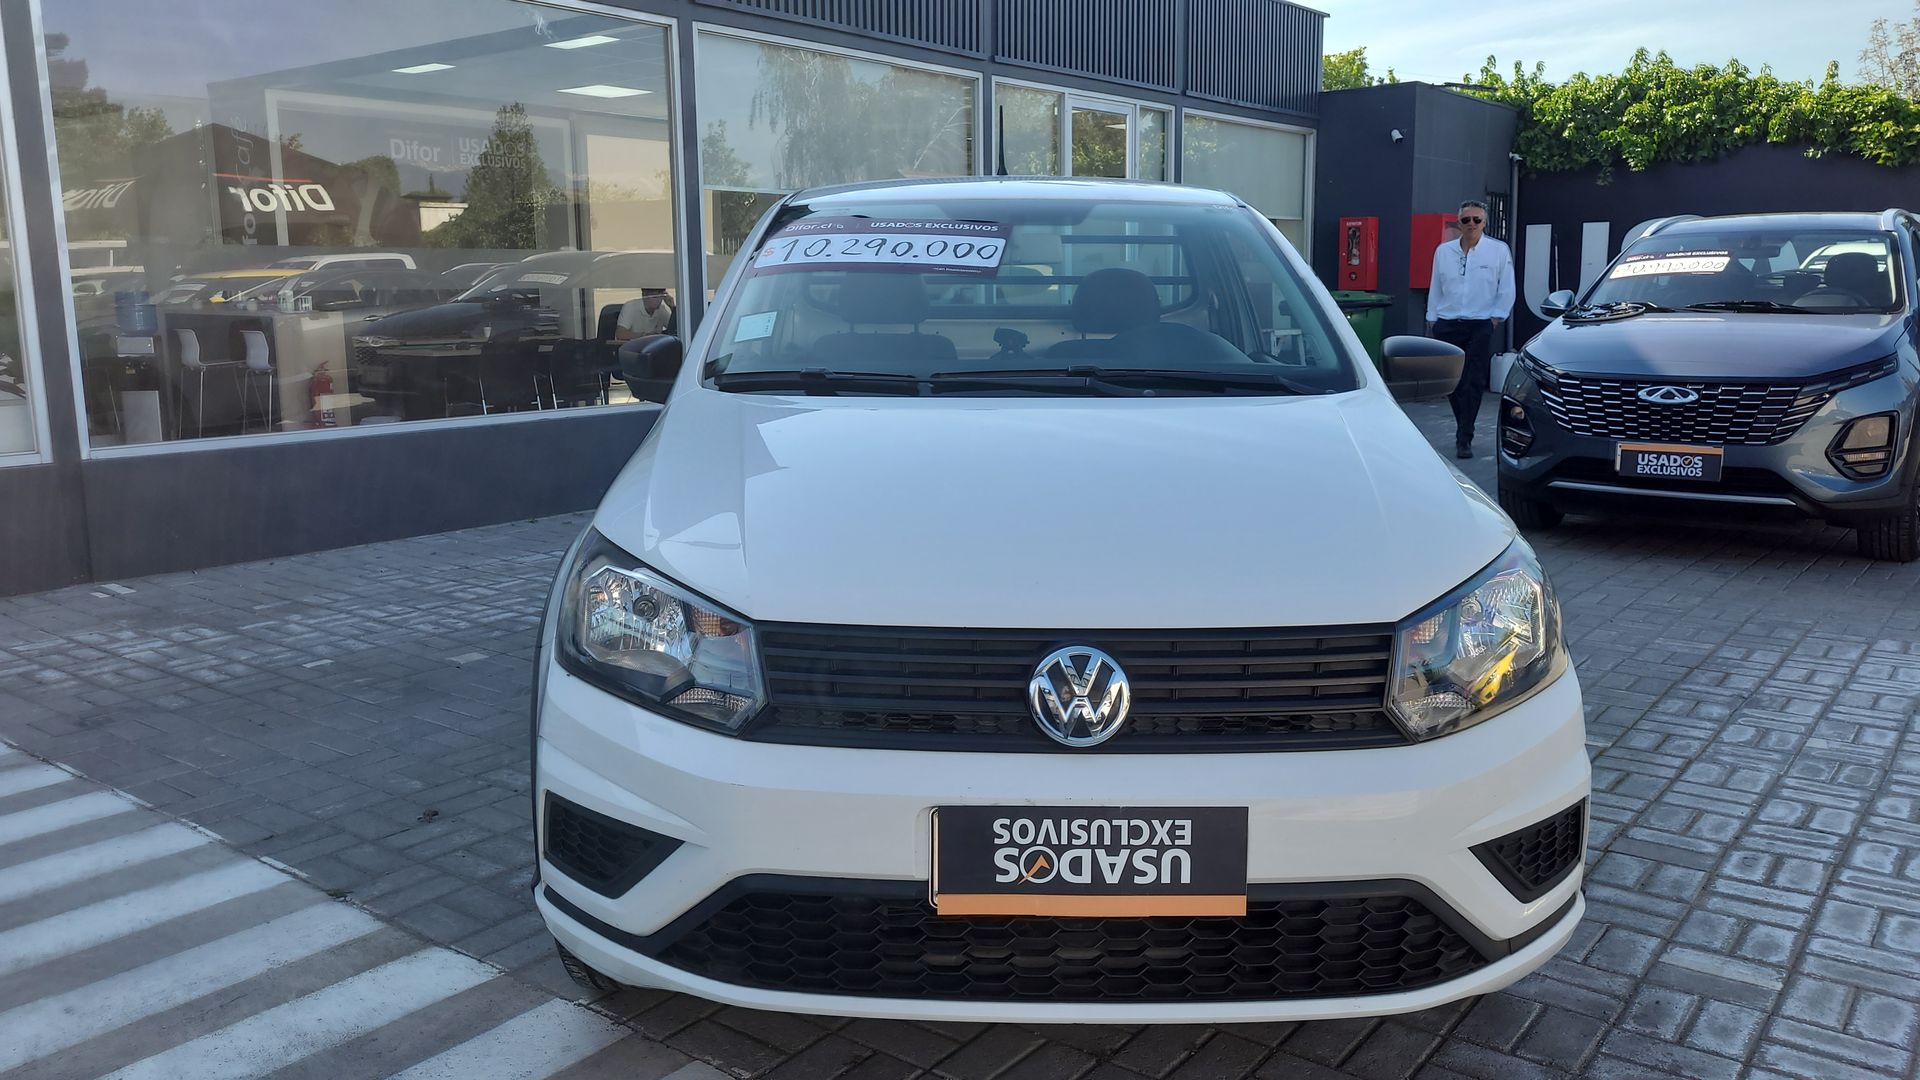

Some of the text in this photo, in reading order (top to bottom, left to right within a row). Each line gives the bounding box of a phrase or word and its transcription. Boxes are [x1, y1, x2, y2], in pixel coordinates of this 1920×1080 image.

[389, 138, 441, 162] Difor
[460, 153, 526, 168] EXCLUSIVOS
[925, 222, 999, 232] EXCLUSIVOS
[1637, 453, 1703, 468] USADOS
[1636, 465, 1703, 477] EXCLUSIVOS
[992, 818, 1192, 846] EXCLUSIVOS
[993, 846, 1191, 885] USADOS
